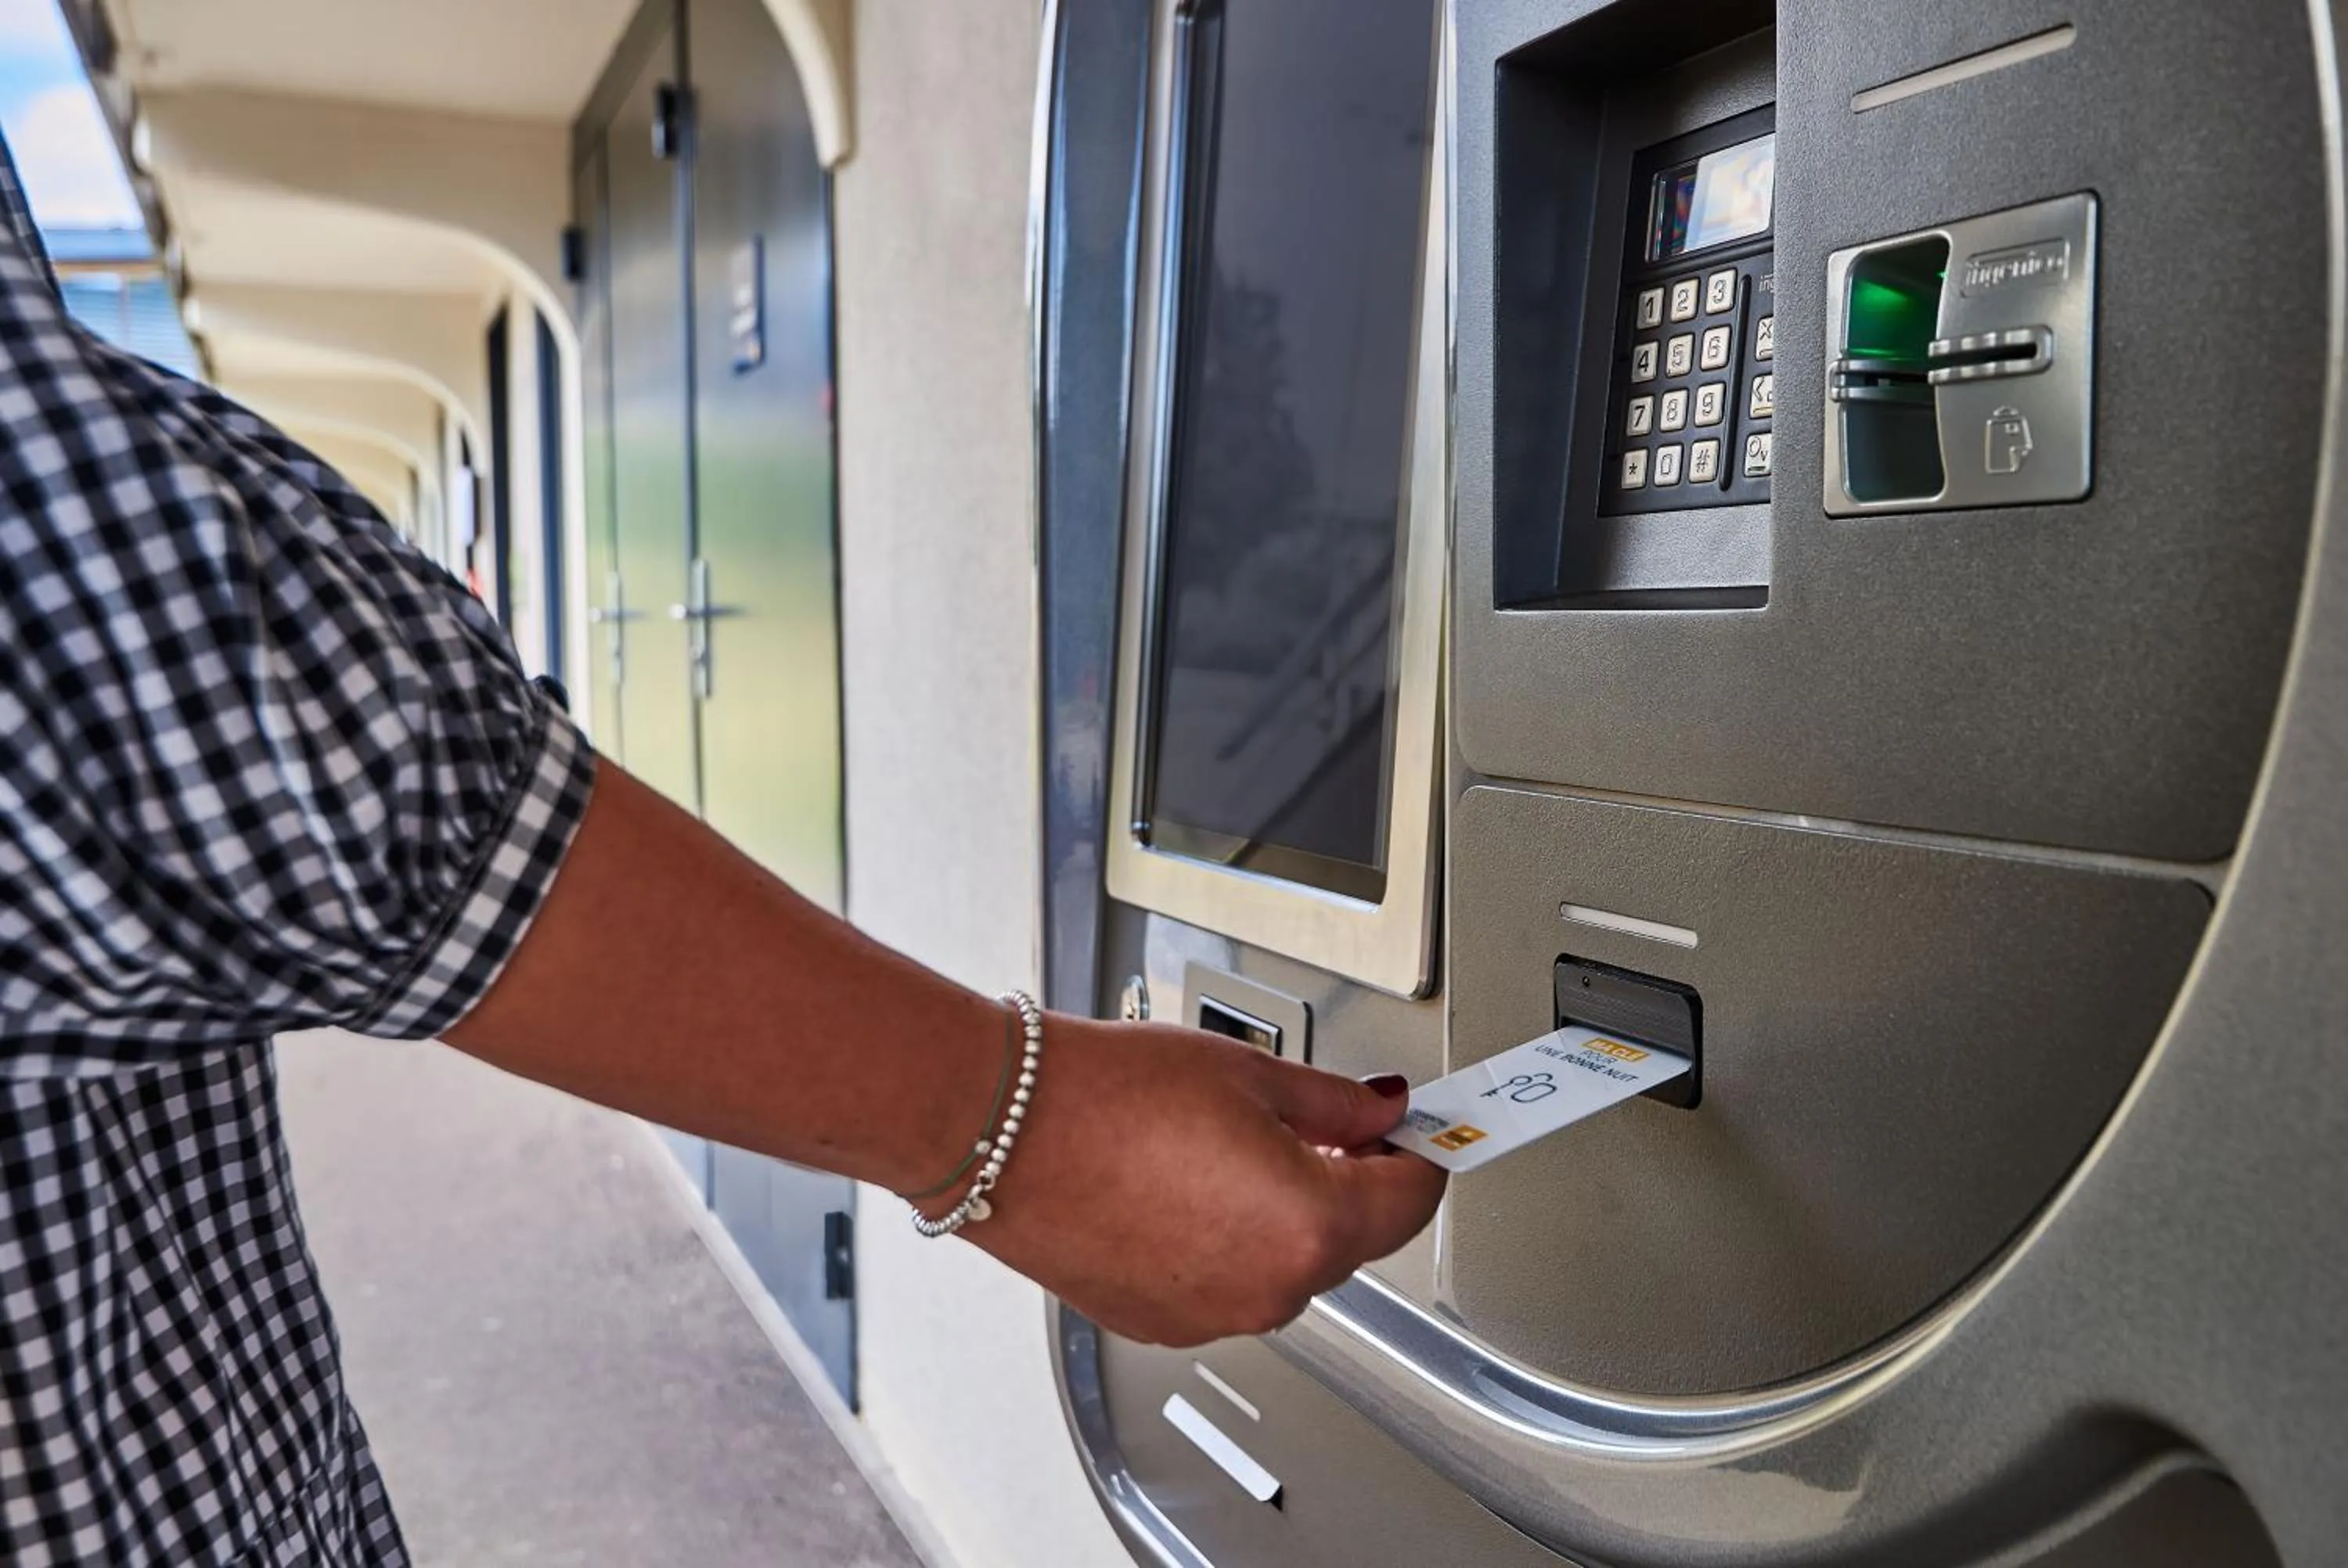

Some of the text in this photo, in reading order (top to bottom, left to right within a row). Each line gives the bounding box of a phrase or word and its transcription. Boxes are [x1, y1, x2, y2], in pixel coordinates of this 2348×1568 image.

[1645, 279, 1725, 317] 1 2 3
[1638, 336, 1720, 372] 4 5 6
[1633, 392, 1714, 426] 7 8 9
[1661, 452, 1673, 477] 0
[1695, 449, 1710, 474] #
[1534, 1044, 1639, 1082] UNE BONNE NUIT
